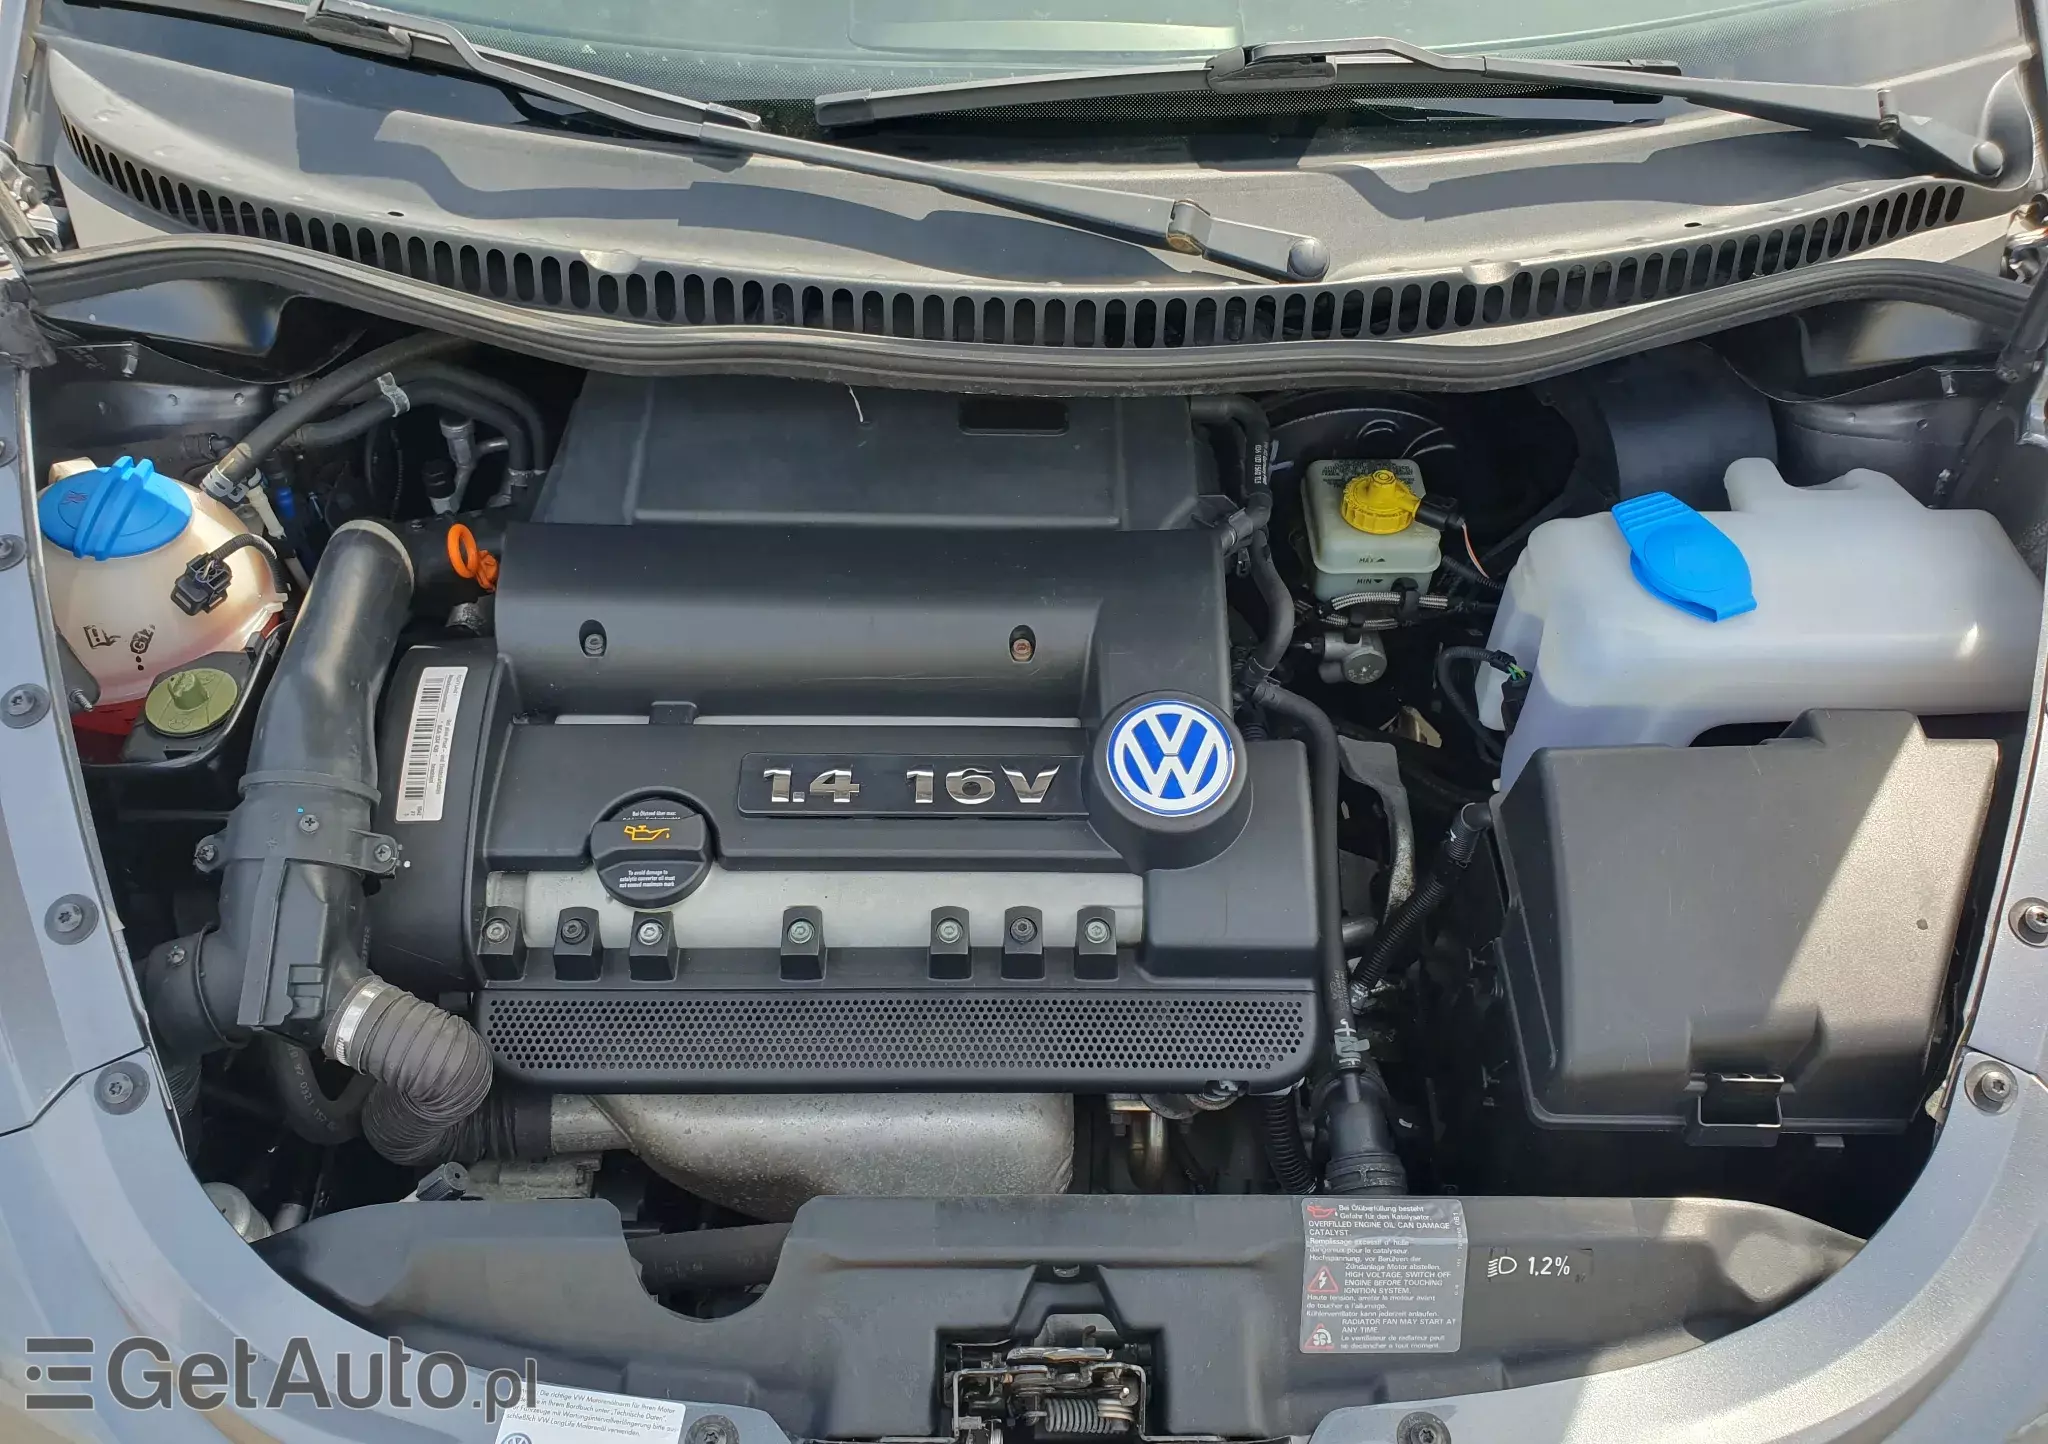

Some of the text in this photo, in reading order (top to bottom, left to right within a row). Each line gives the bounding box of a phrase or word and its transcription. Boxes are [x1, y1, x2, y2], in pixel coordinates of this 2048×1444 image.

[1111, 703, 1230, 813] VW
[764, 764, 1061, 804] 1.4 16V
[1352, 1203, 1396, 1212] Ölüberfüllung
[1345, 1263, 1385, 1271] Zündanlage
[549, 1400, 564, 1408] Ihrem
[566, 1402, 594, 1411] Bordbuch
[550, 1391, 572, 1400] richtige
[586, 1396, 631, 1408] Motorenölnorm
[658, 1406, 676, 1414] Motor
[550, 1418, 575, 1427] LongLife
[576, 1422, 606, 1431] Motorenöl
[653, 1423, 665, 1431] bitte
